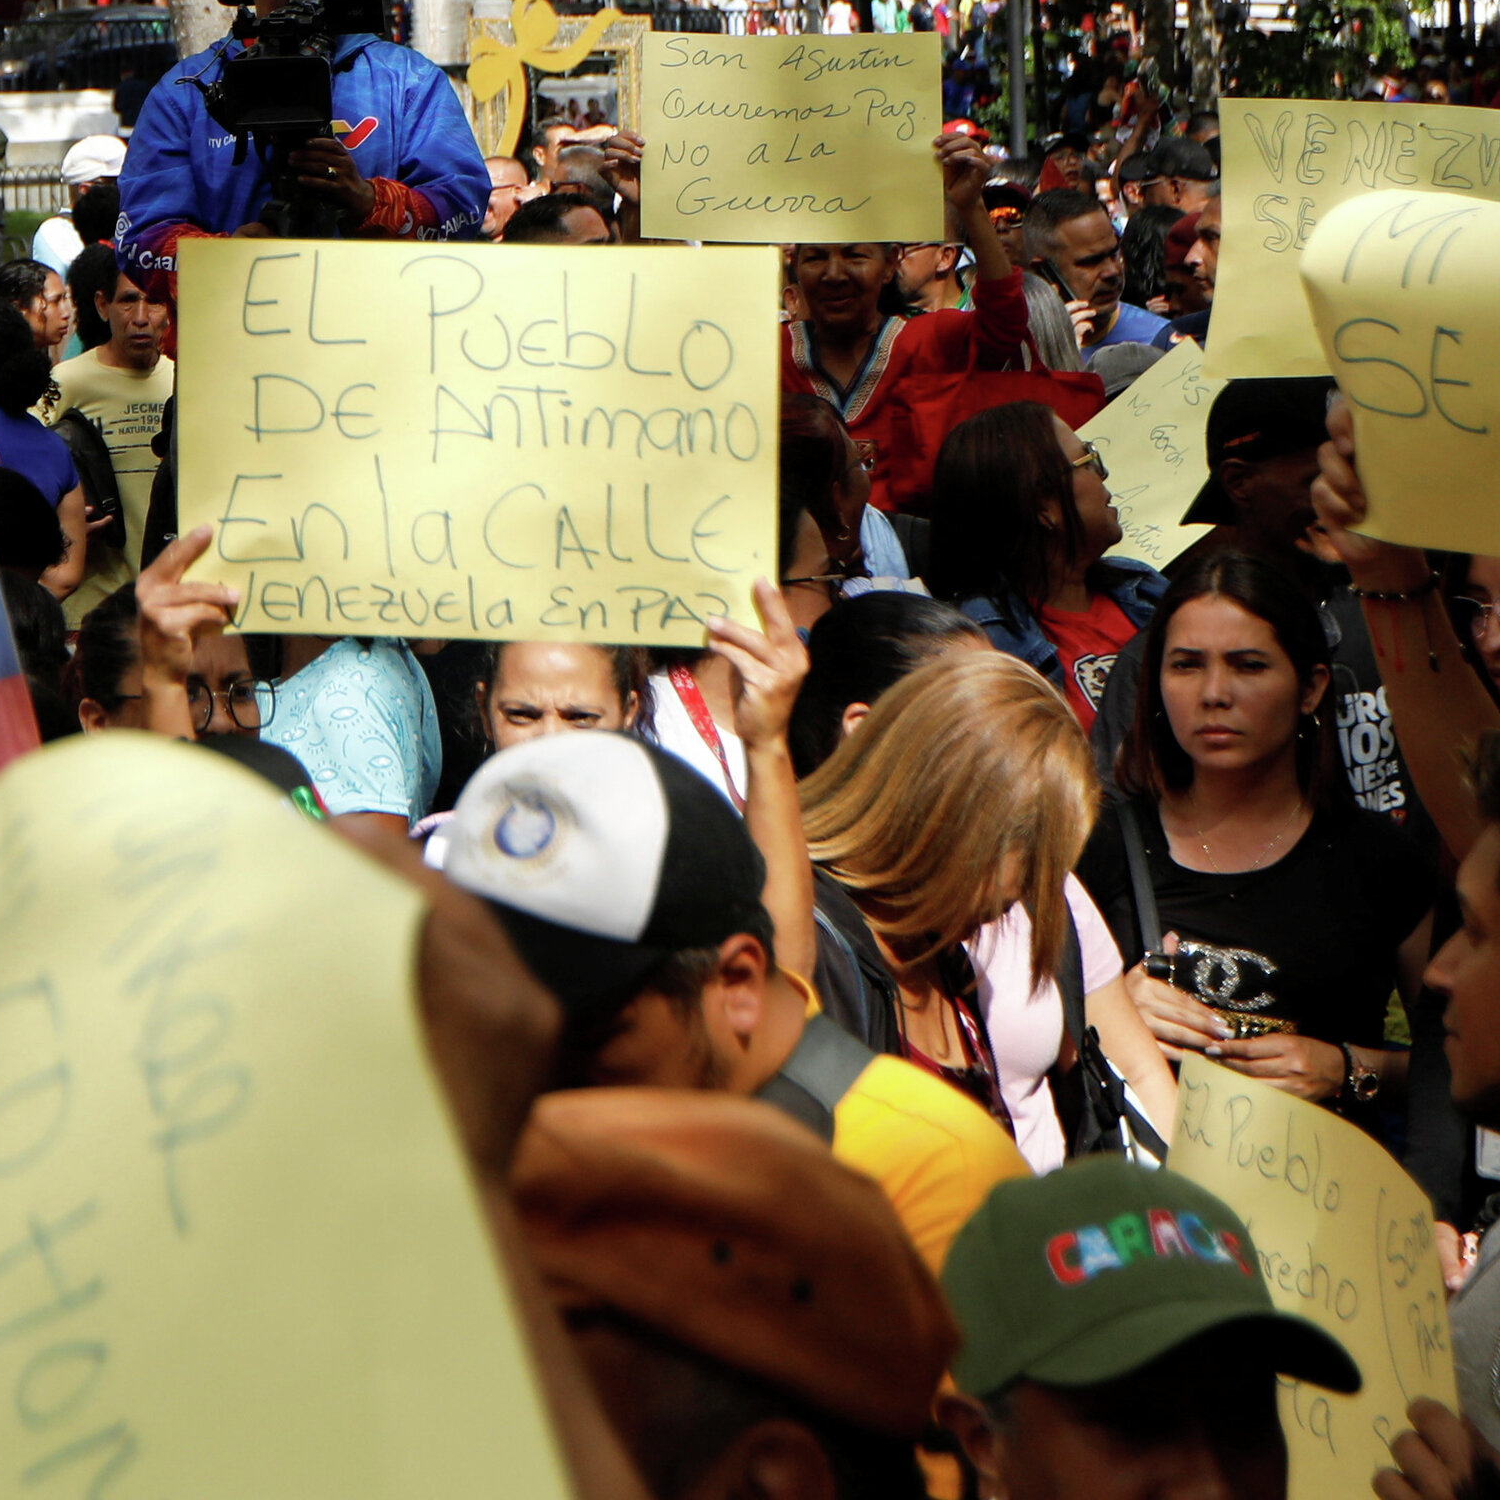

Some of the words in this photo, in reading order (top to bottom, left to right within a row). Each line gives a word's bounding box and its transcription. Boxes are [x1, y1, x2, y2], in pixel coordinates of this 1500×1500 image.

[659, 36, 748, 71] San
[675, 175, 873, 216] Guerra
[242, 248, 367, 345] EL
[117, 425, 158, 436] NATURAL
[244, 372, 383, 444] DE
[1224, 1093, 1341, 1212] Pueblo
